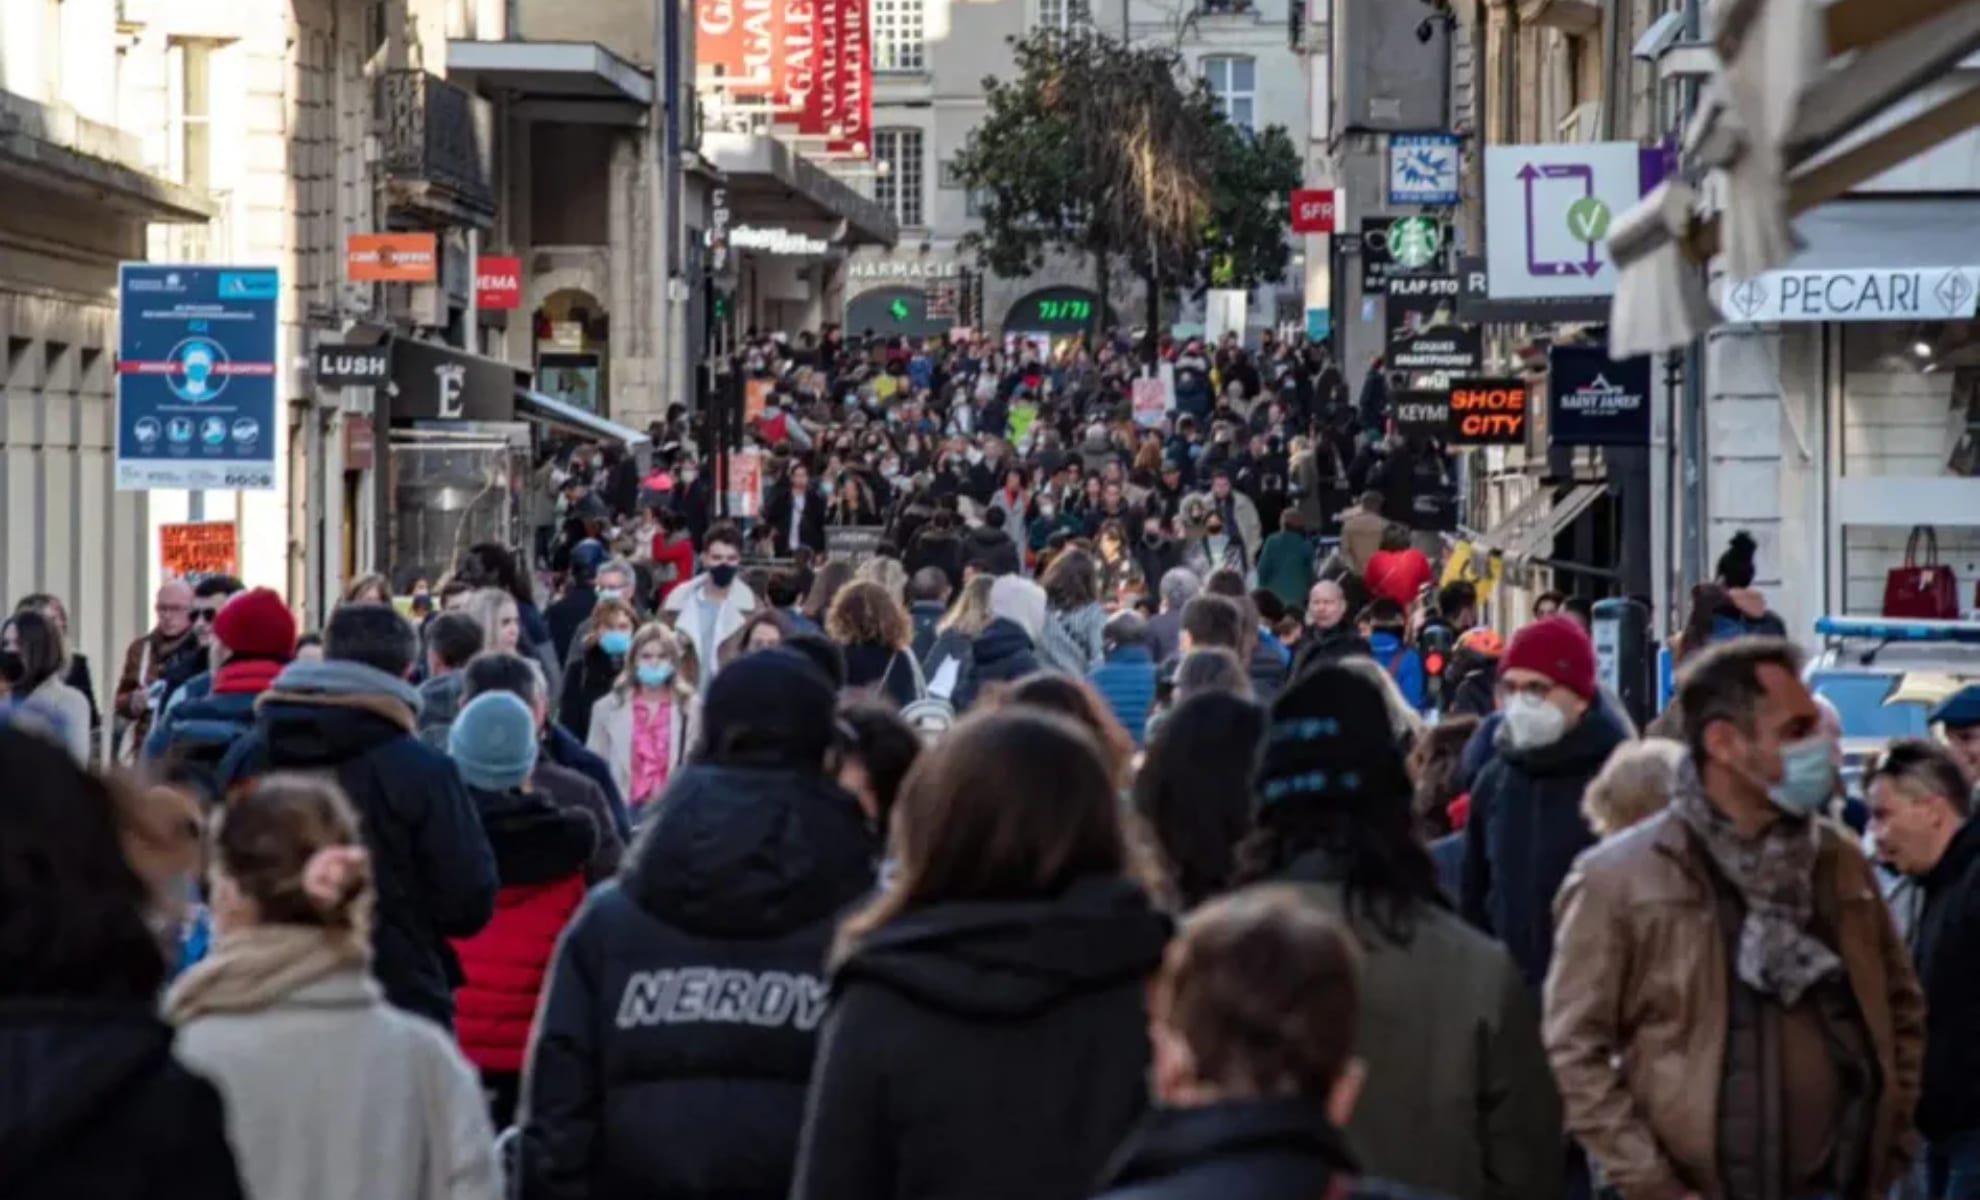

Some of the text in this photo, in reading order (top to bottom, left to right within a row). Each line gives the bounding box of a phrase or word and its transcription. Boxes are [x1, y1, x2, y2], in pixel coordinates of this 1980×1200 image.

[1301, 203, 1334, 220] SFR
[1391, 280, 1430, 294] FLAP
[1779, 272, 1920, 314] PECARI
[321, 355, 386, 375] LUSH
[1451, 389, 1525, 409] SHOE
[1461, 414, 1523, 435] CITY
[615, 966, 829, 1029] NERDY
